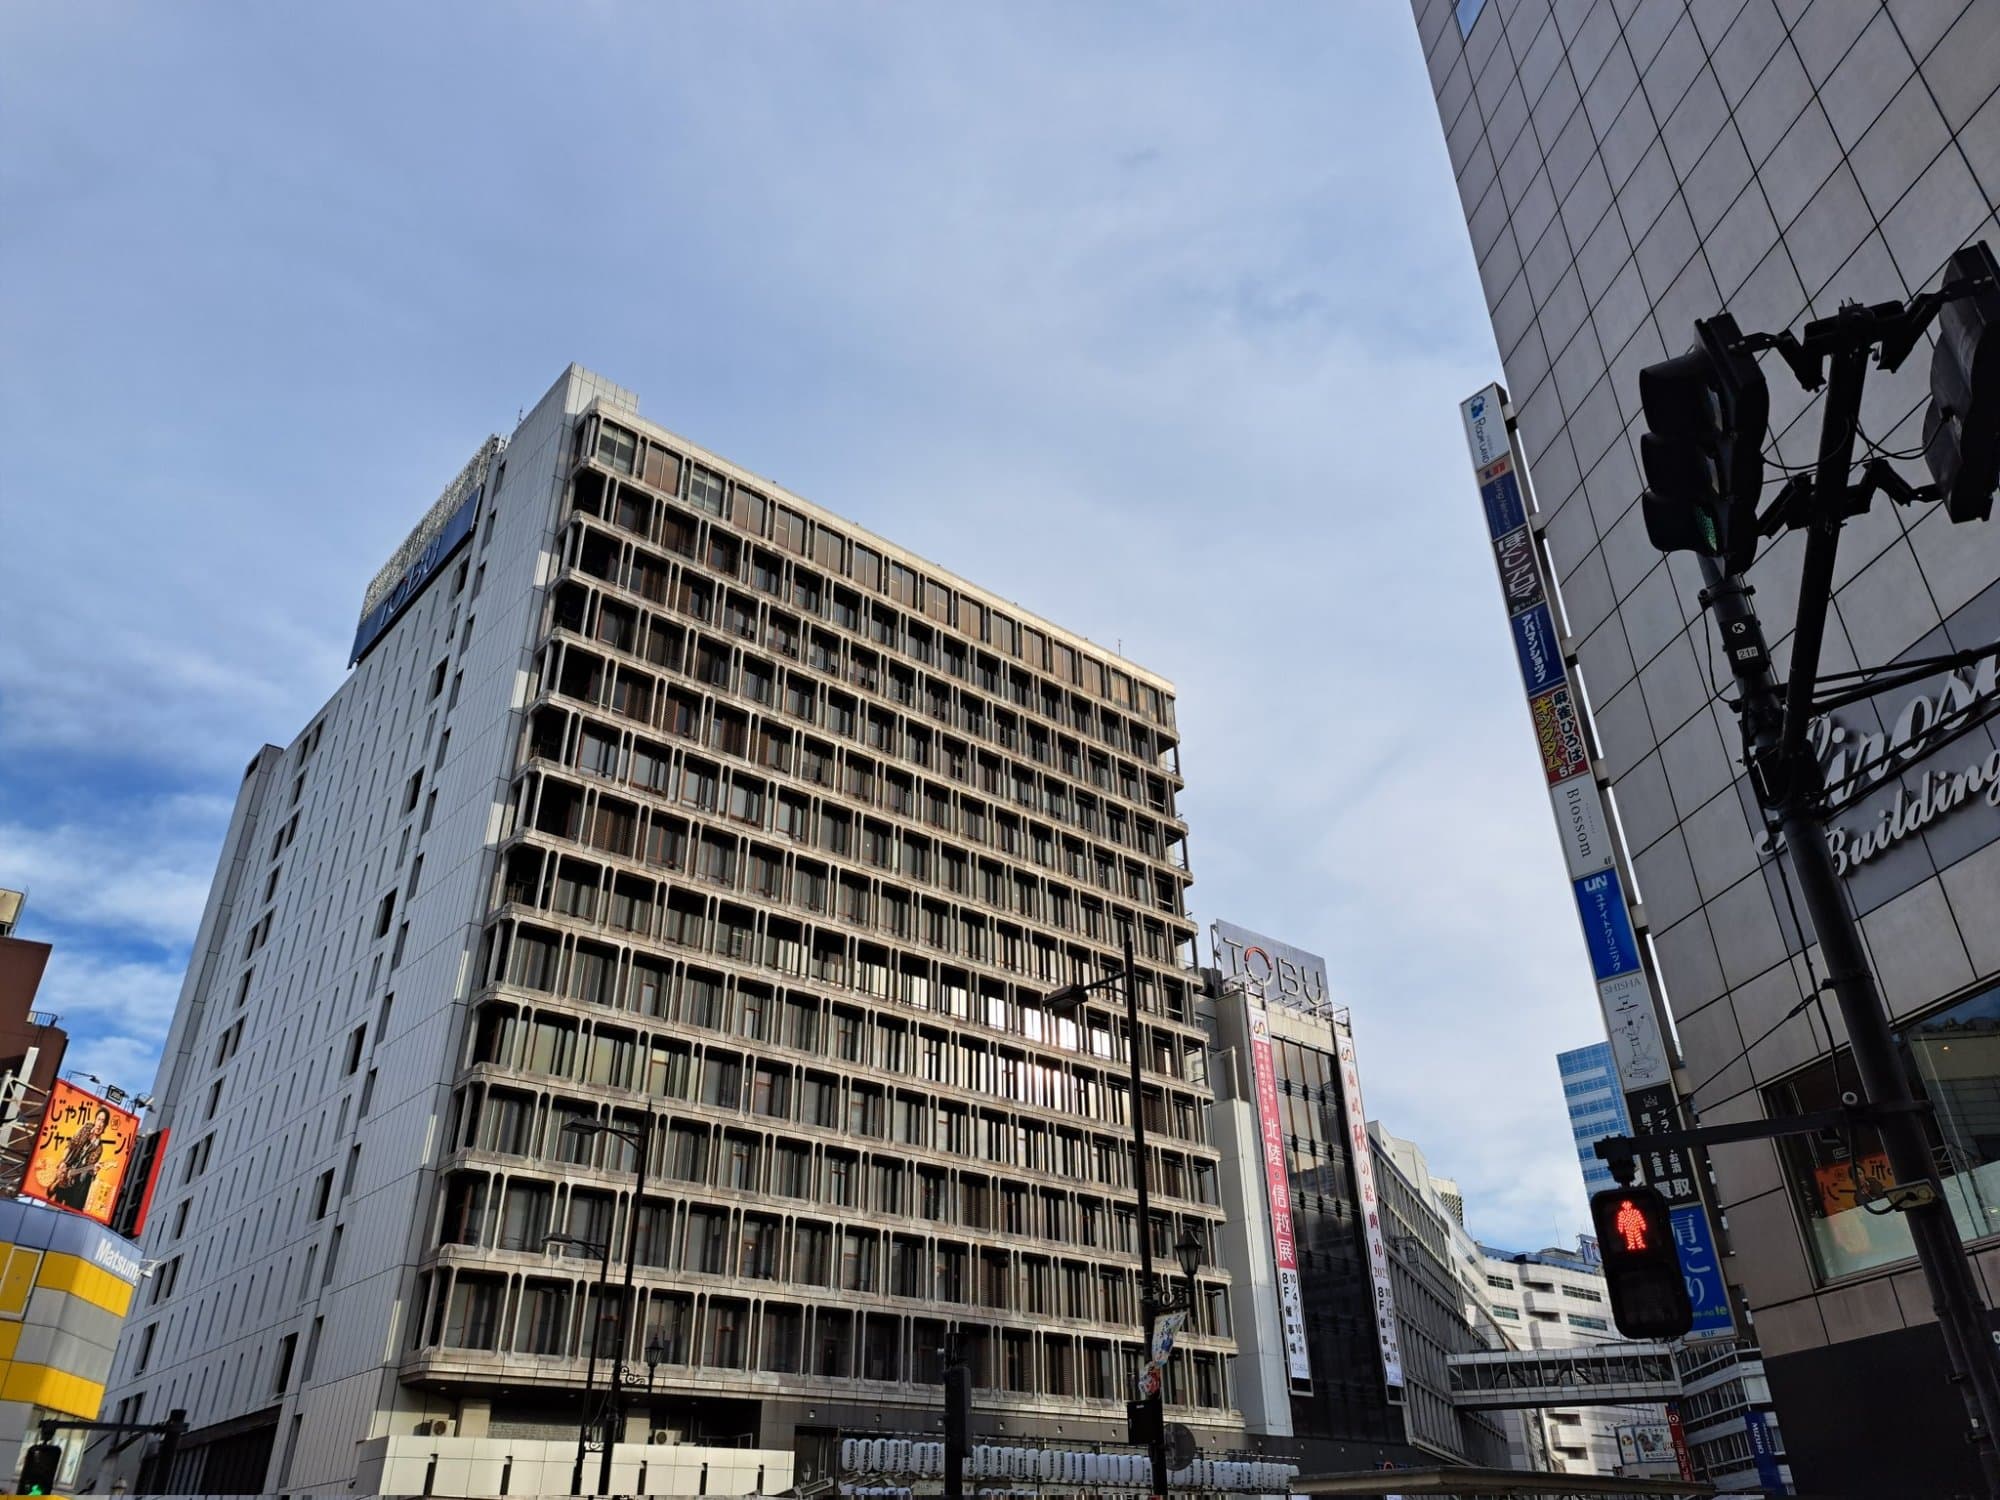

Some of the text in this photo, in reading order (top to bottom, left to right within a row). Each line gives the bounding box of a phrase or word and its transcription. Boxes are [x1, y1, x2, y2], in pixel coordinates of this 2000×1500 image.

[1534, 697, 1563, 770] キングダム
[1553, 688, 1585, 764] 麻雀ひろば
[1559, 765, 1577, 779] 5F
[1566, 787, 1592, 858] Blossom
[1825, 751, 2000, 877] Building
[1223, 936, 1322, 1006] TOBU
[1603, 977, 1642, 995] SHISHA
[50, 1099, 93, 1125] じゃが
